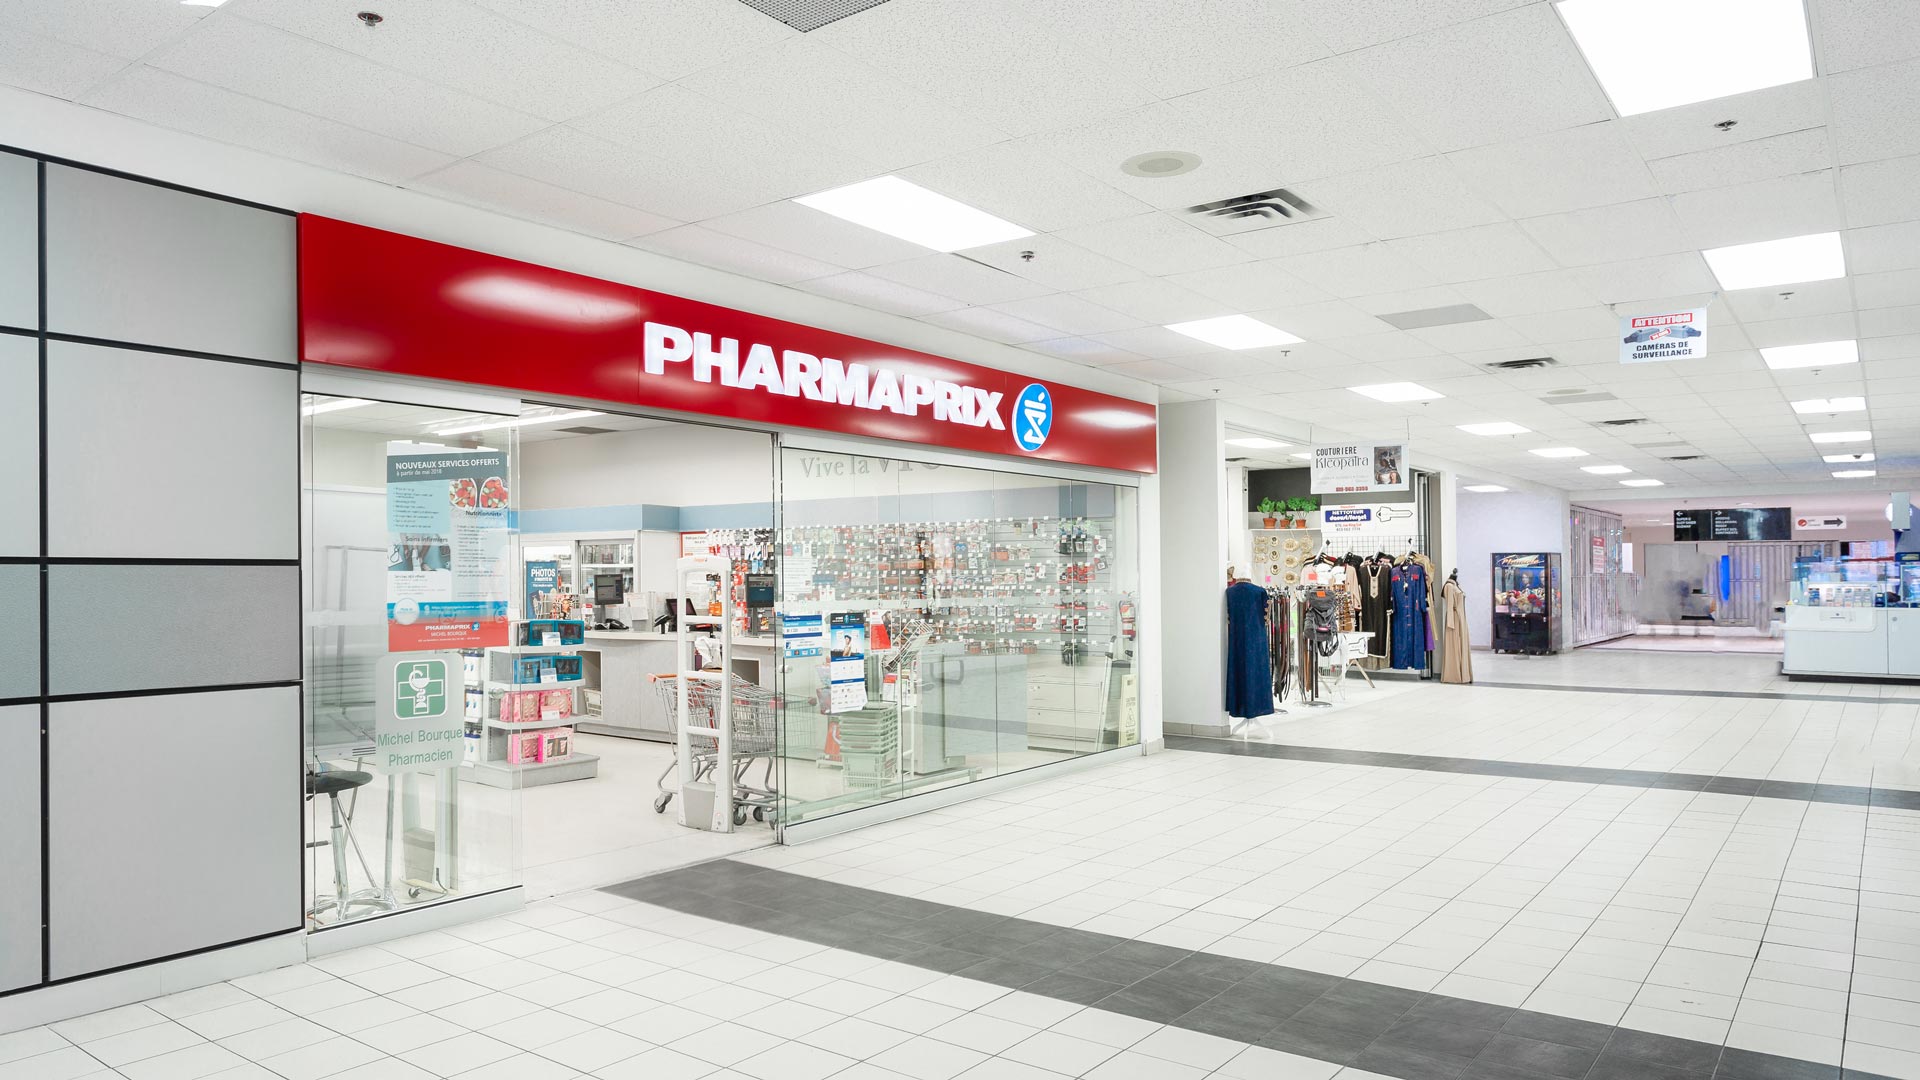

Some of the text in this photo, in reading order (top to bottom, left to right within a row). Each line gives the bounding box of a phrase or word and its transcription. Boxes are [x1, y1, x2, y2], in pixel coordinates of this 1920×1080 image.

[1634, 313, 1691, 327] ATTENTION
[1632, 348, 1693, 359] SURVEILLANCE
[643, 321, 1006, 431] PHARMAPRIX
[1316, 446, 1357, 457] COUTURIERE
[395, 458, 500, 470] NOUVEAUX SERVICES OFFERTS
[800, 456, 844, 478] Vive
[850, 455, 870, 475] la
[1316, 456, 1369, 470] Kleopatra
[400, 469, 414, 477] partir
[421, 535, 448, 543] infirmiers
[531, 568, 556, 577] PHOTOS
[377, 728, 463, 747] Michel Bourque
[388, 749, 453, 767] Pharmacien
